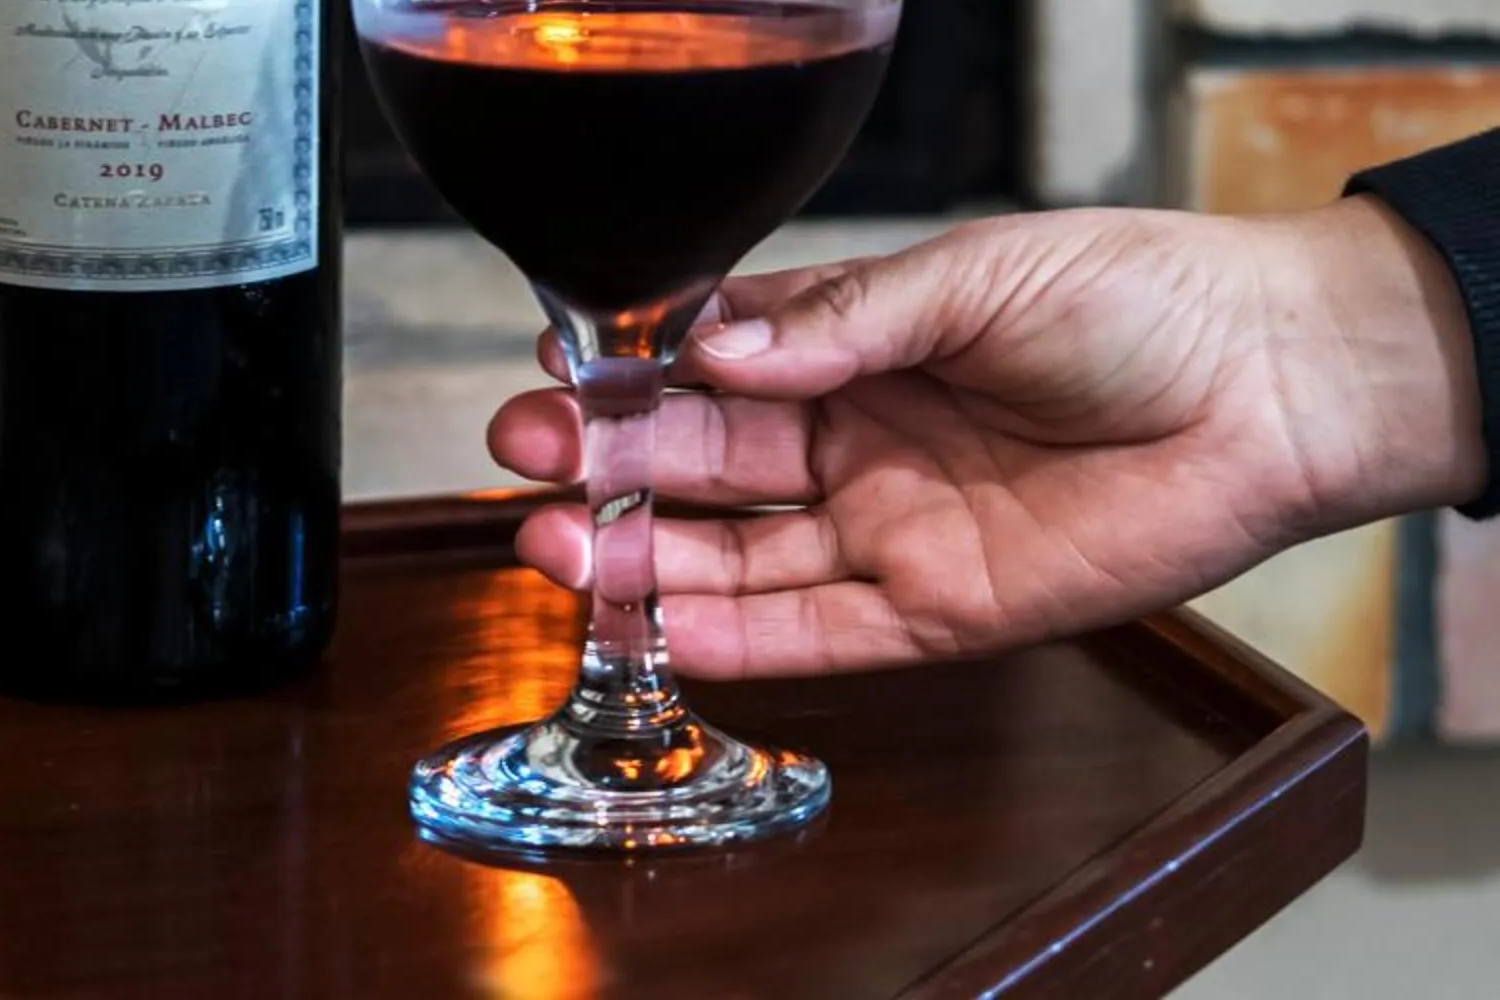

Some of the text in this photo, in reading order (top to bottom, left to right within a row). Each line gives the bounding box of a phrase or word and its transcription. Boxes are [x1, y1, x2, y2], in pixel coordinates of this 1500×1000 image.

[15, 110, 134, 133] CABERNET
[157, 111, 253, 132] MALBEC
[99, 162, 165, 182] 2019
[53, 191, 130, 210] CATENA
